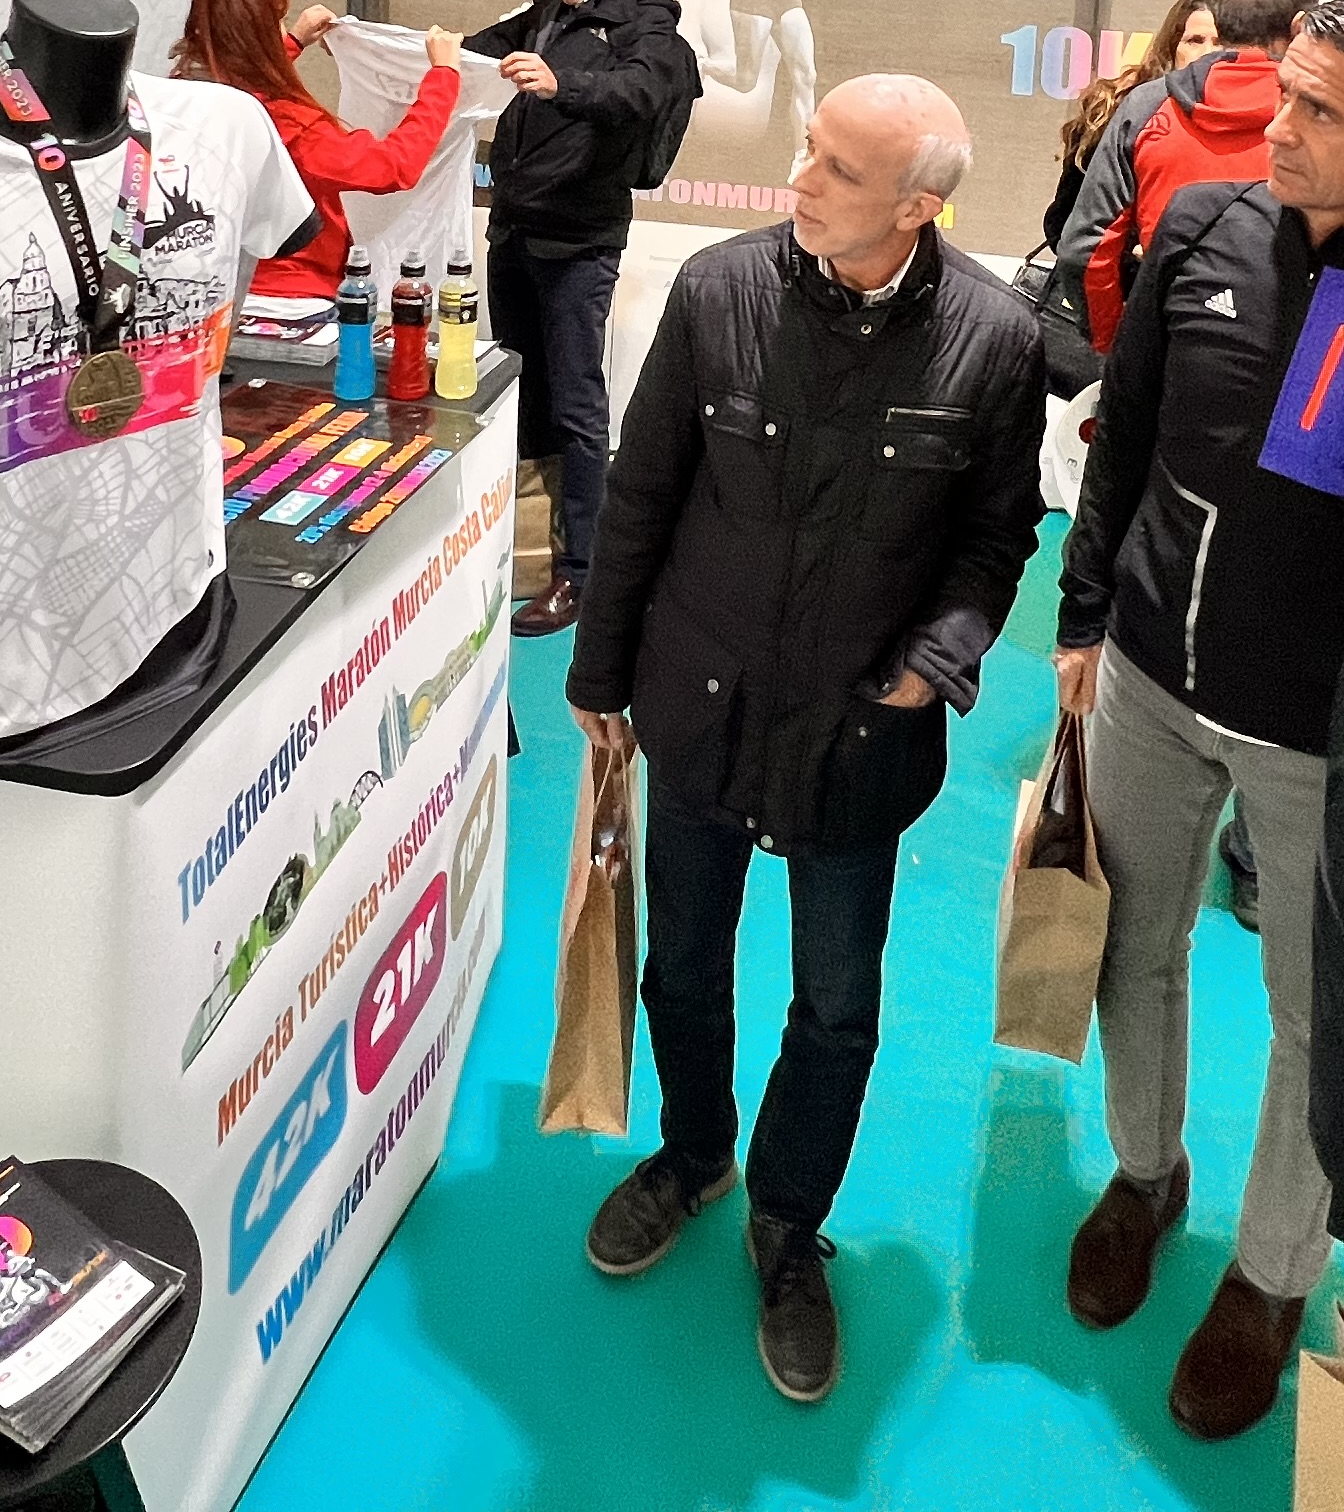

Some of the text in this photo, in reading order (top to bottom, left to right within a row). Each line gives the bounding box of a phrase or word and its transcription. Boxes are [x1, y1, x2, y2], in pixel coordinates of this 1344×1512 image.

[54, 180, 100, 297] ANIVERSARIO
[310, 467, 345, 491] 21K
[178, 704, 318, 925] TotalEnergies
[320, 615, 392, 731] Maratón
[391, 555, 443, 642] Murcia
[442, 509, 482, 576] Costa
[371, 899, 440, 1047] 21K
[217, 1004, 294, 1148] Murcia
[244, 1045, 340, 1233] 42K
